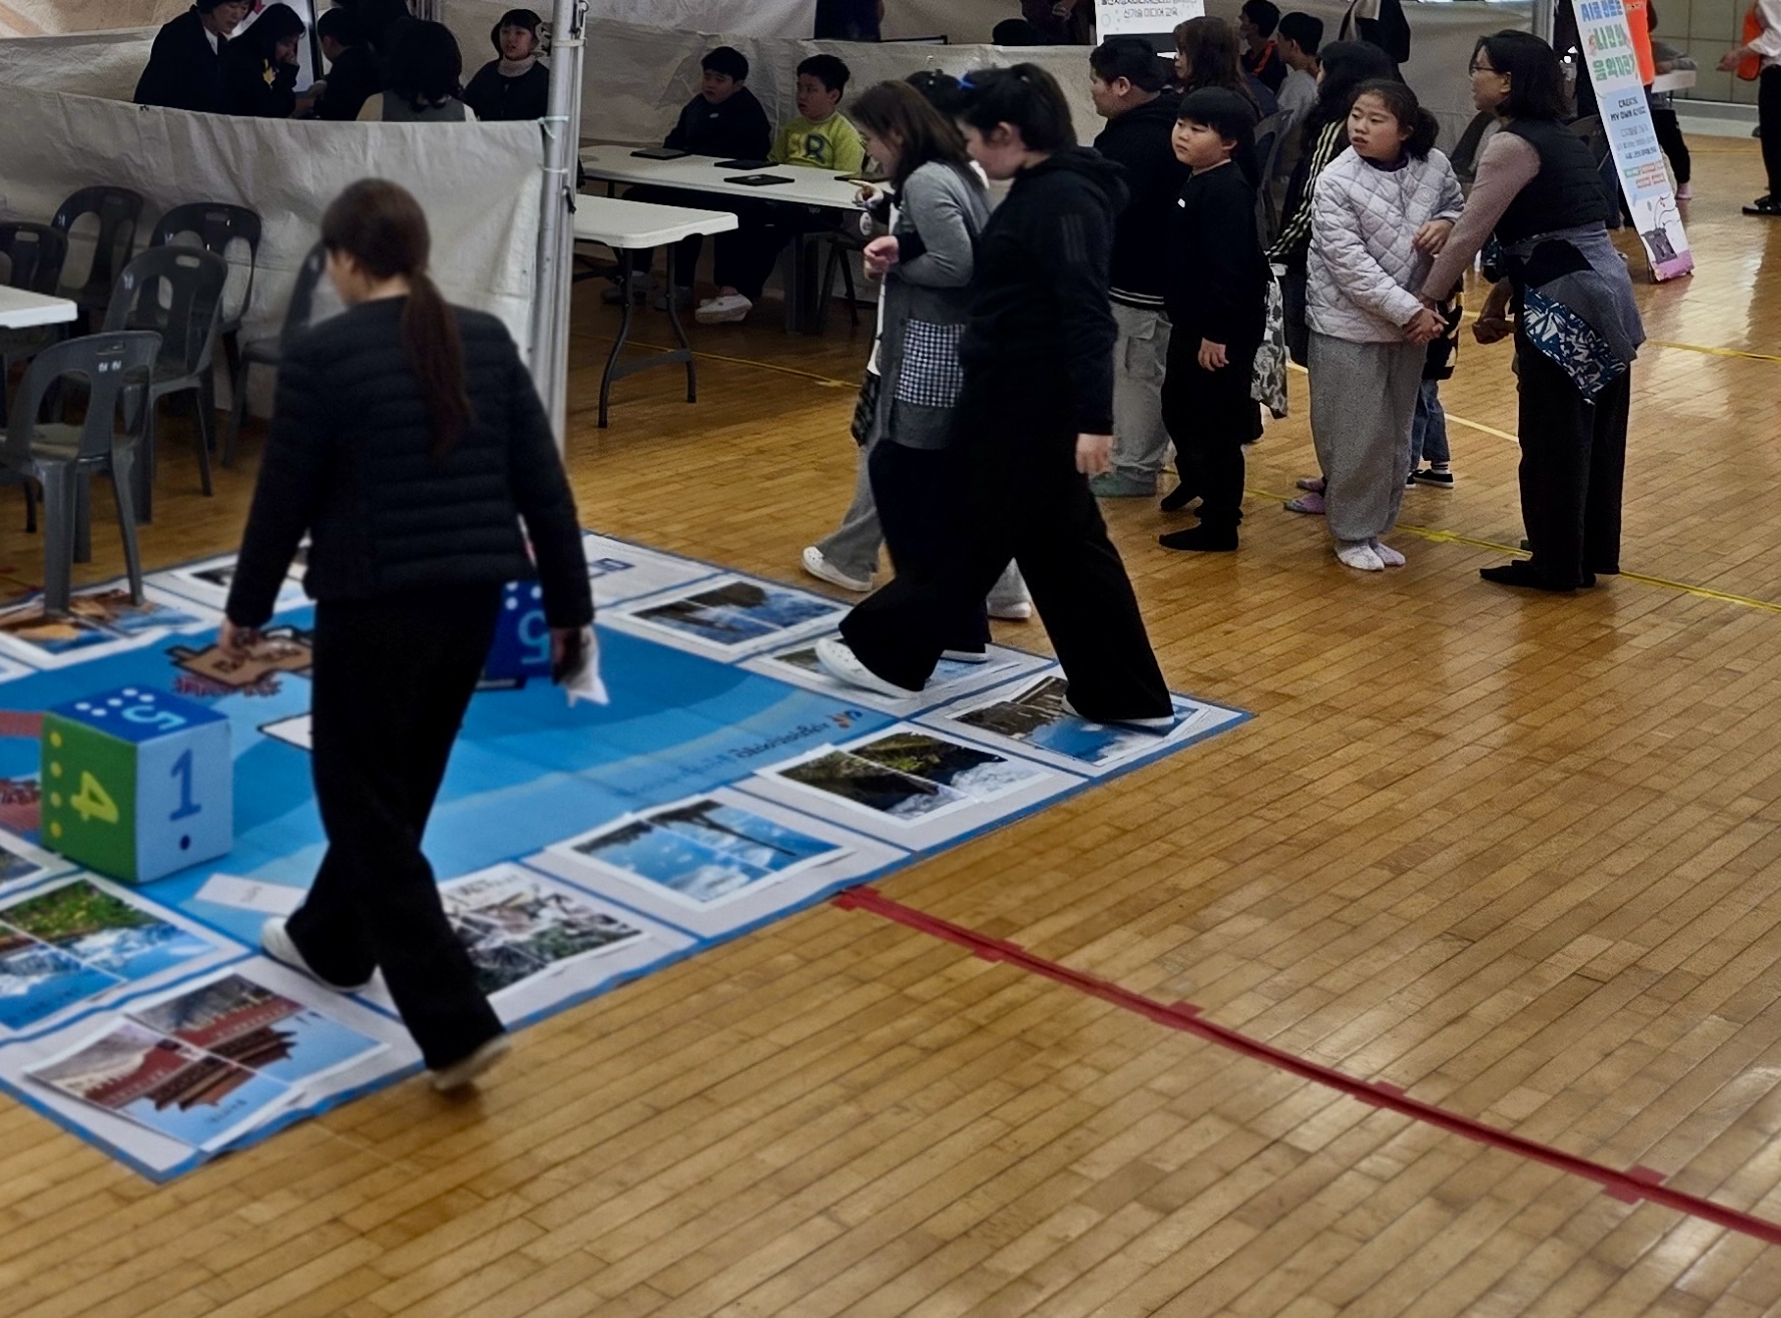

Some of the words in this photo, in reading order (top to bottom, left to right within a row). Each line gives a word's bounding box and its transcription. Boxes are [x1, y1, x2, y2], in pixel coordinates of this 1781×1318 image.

[122, 705, 186, 731] 5
[71, 769, 119, 824] 4
[170, 748, 202, 822] 1
